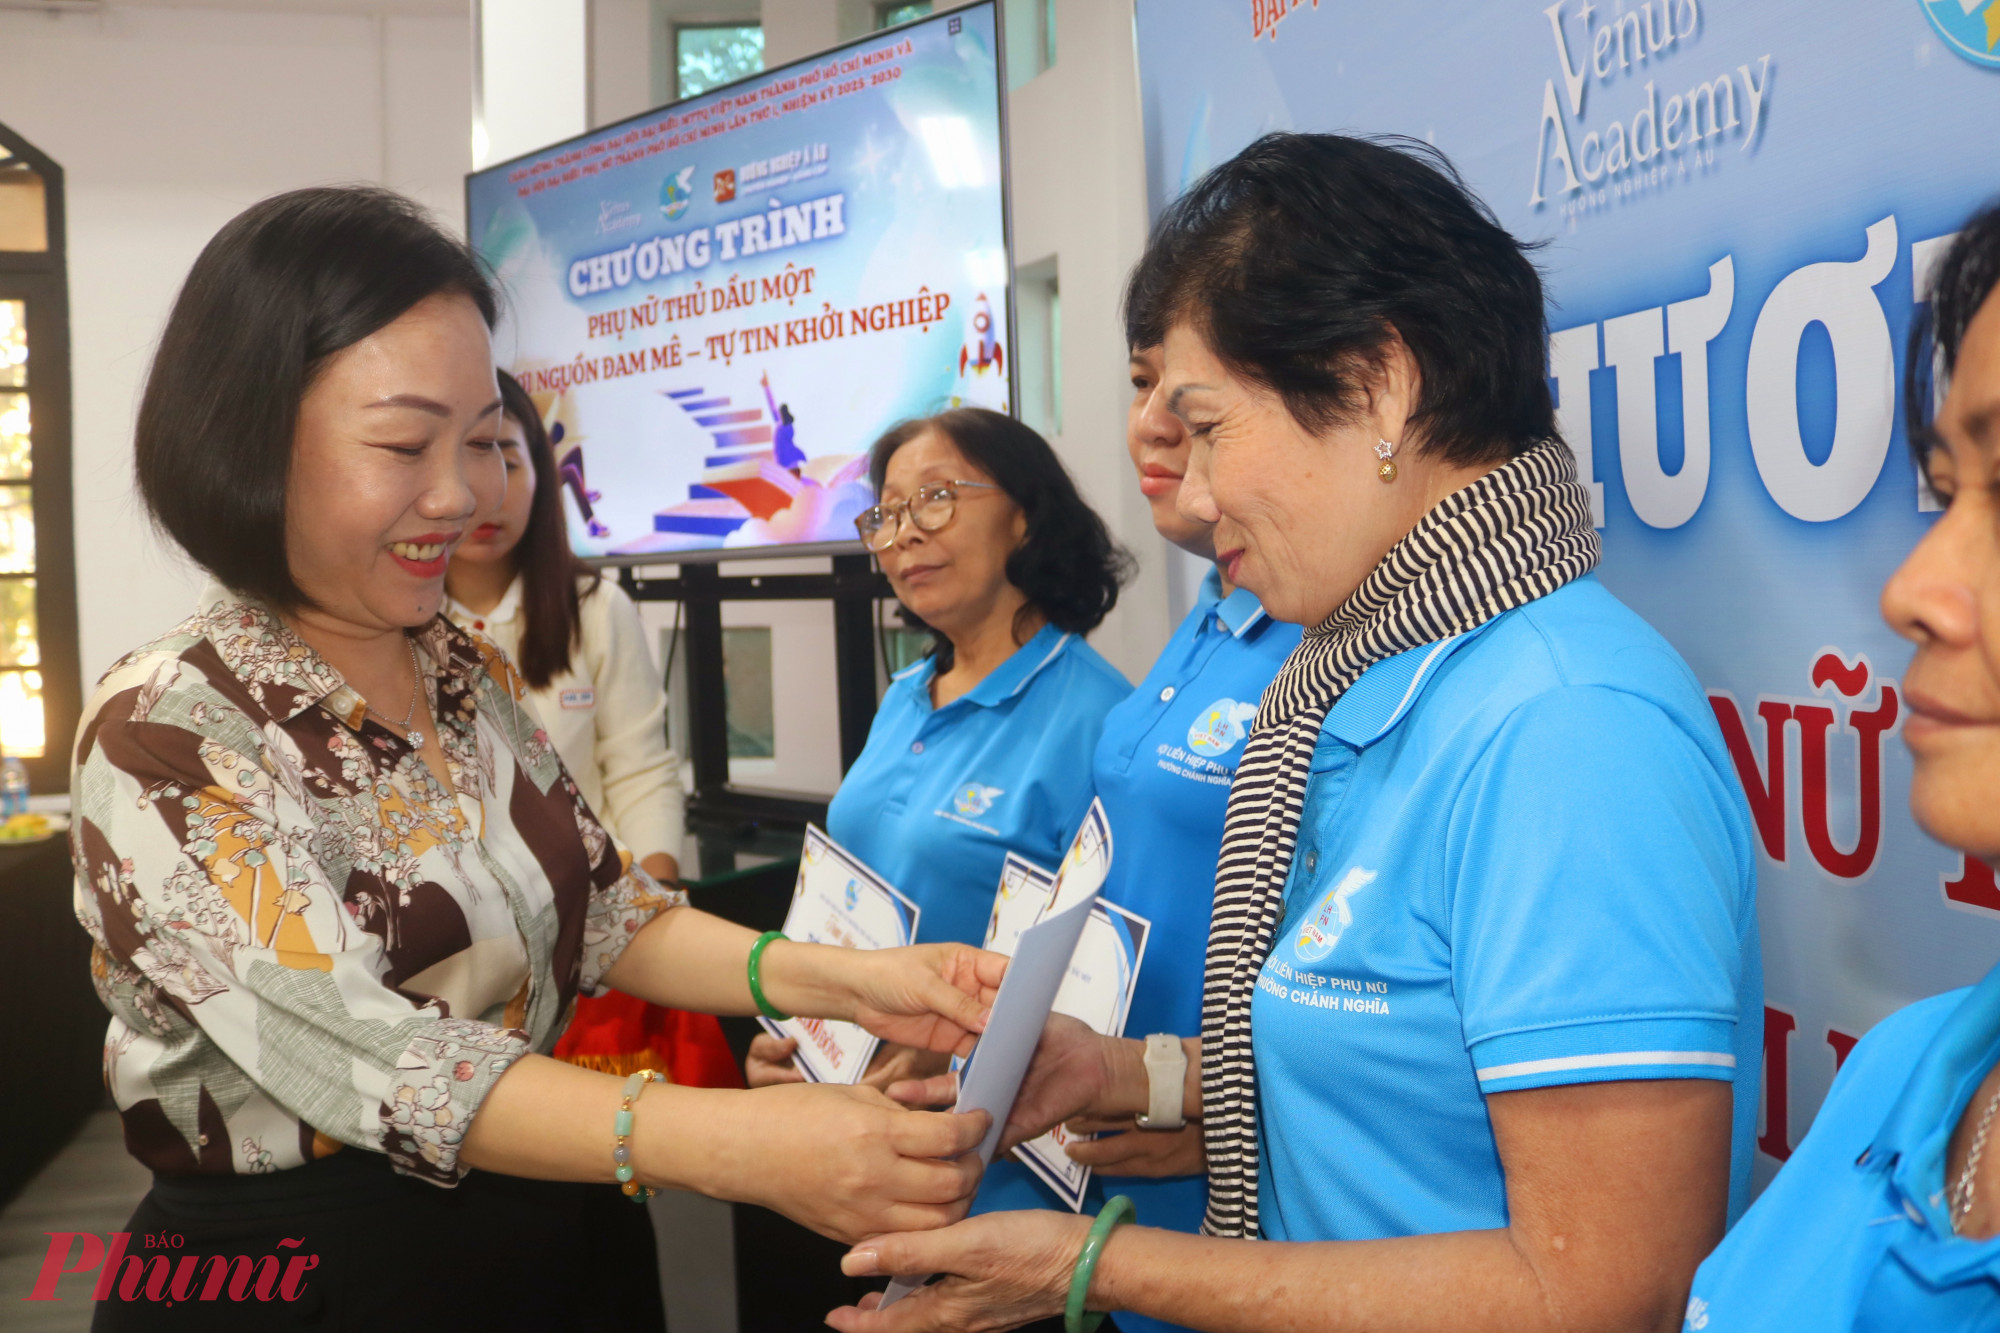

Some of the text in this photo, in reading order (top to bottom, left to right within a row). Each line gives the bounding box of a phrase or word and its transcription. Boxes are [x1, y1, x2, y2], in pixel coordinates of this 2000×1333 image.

[711, 97, 734, 117] VIỆT
[736, 91, 757, 108] NAM
[760, 78, 796, 101] THÀNH
[799, 64, 821, 88] PHỐ
[823, 59, 839, 80] HỒ
[841, 53, 860, 76] CHÍ
[862, 46, 894, 68] MINH
[896, 37, 912, 56] VÀ
[1543, 0, 1698, 115] Venus
[681, 126, 697, 145] CHÍ
[700, 119, 726, 139] MINH
[782, 89, 818, 112] NHIỆM
[1528, 54, 1771, 207] Academy
[568, 194, 845, 297] CHƯƠNG TRÌNH
[587, 309, 626, 340] PHỤ
[631, 295, 660, 330] NỮ
[663, 281, 706, 323] THỦ
[761, 262, 815, 306] MỘT
[603, 350, 646, 380] ĐAM
[651, 334, 682, 371] MÊ
[705, 329, 737, 366] TỰ
[740, 324, 779, 355] TIN
[785, 302, 844, 347] KHỞI
[851, 285, 951, 335] NGHIỆP
[1546, 214, 1958, 530] HƯƠ
[1181, 768, 1207, 783] CHÁNH
[1290, 990, 1339, 1011] CHÁNH
[1343, 997, 1390, 1015] NGHĨA
[1295, 971, 1327, 989] HIỆP
[1331, 977, 1362, 995] PHỤ
[1366, 981, 1388, 994] NỮ
